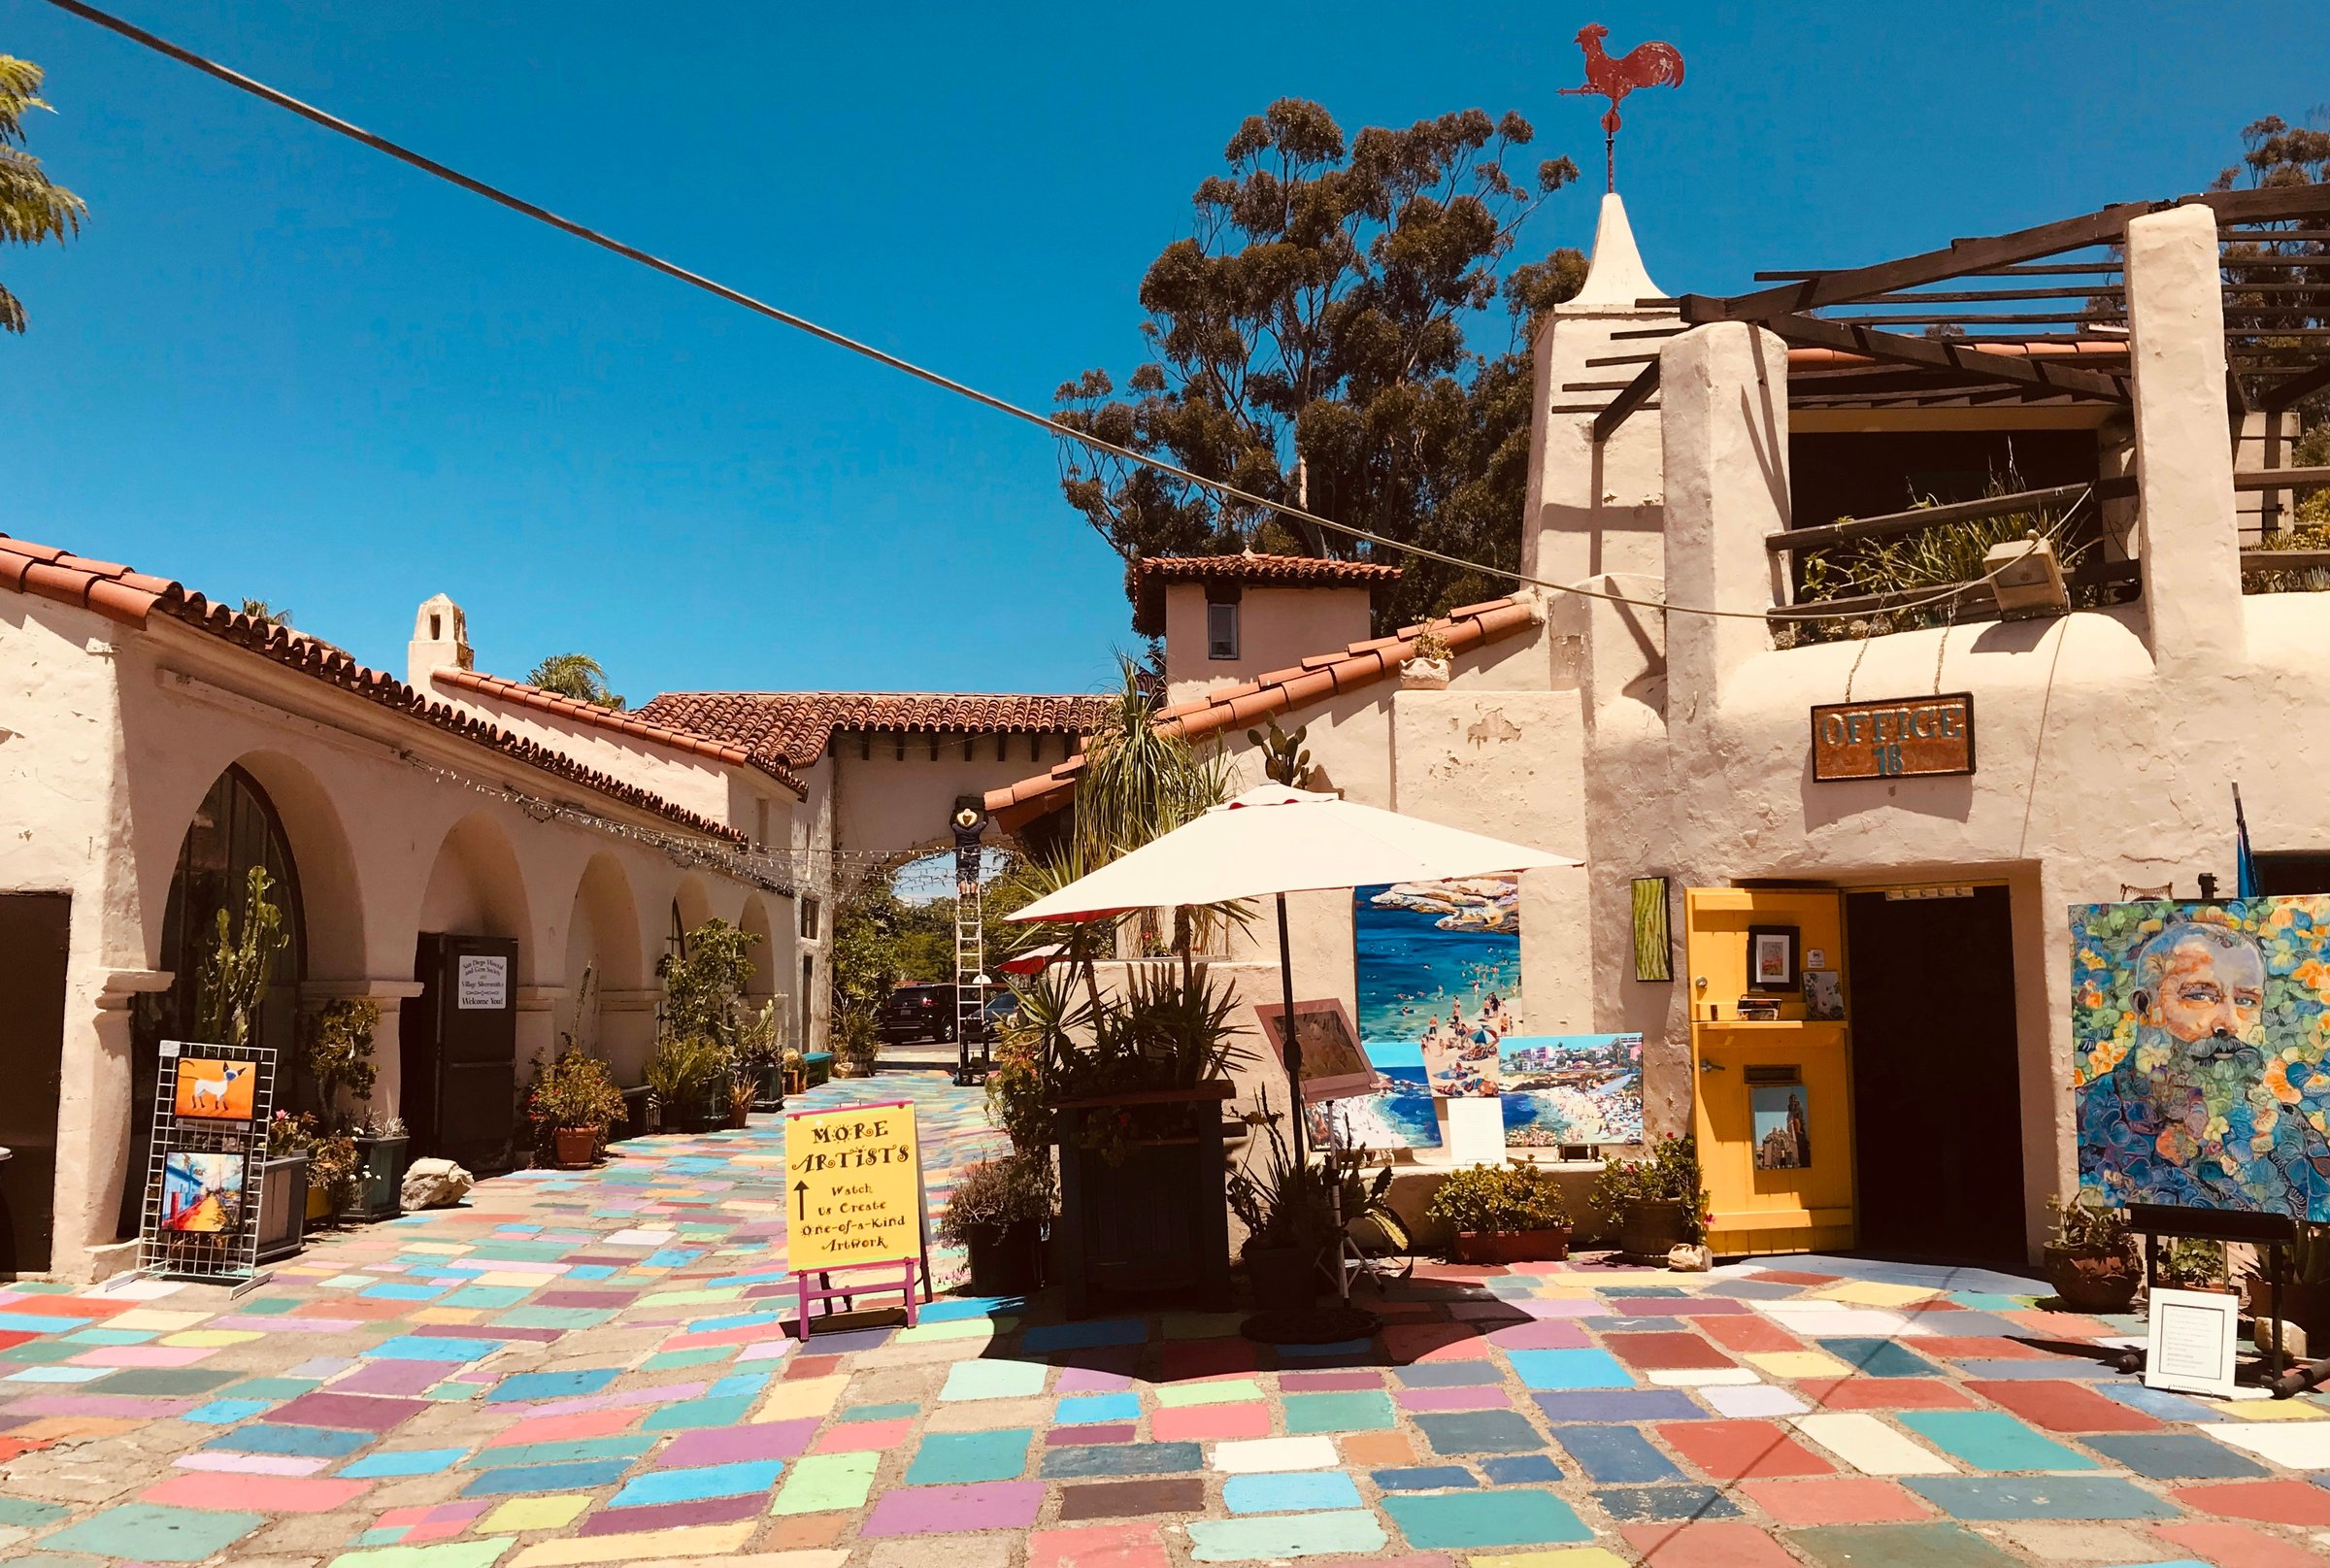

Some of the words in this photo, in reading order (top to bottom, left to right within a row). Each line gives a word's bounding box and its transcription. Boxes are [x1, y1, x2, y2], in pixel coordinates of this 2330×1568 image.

[1821, 707, 1963, 746] OFFICE
[1873, 743, 1904, 776] 18
[812, 1120, 889, 1144] MORE
[831, 1184, 873, 1196] Watch
[817, 1206, 832, 1216] Us
[840, 1201, 886, 1214] Create
[801, 1216, 906, 1237] One-of-a-Kind
[821, 1235, 889, 1252] Artwork
